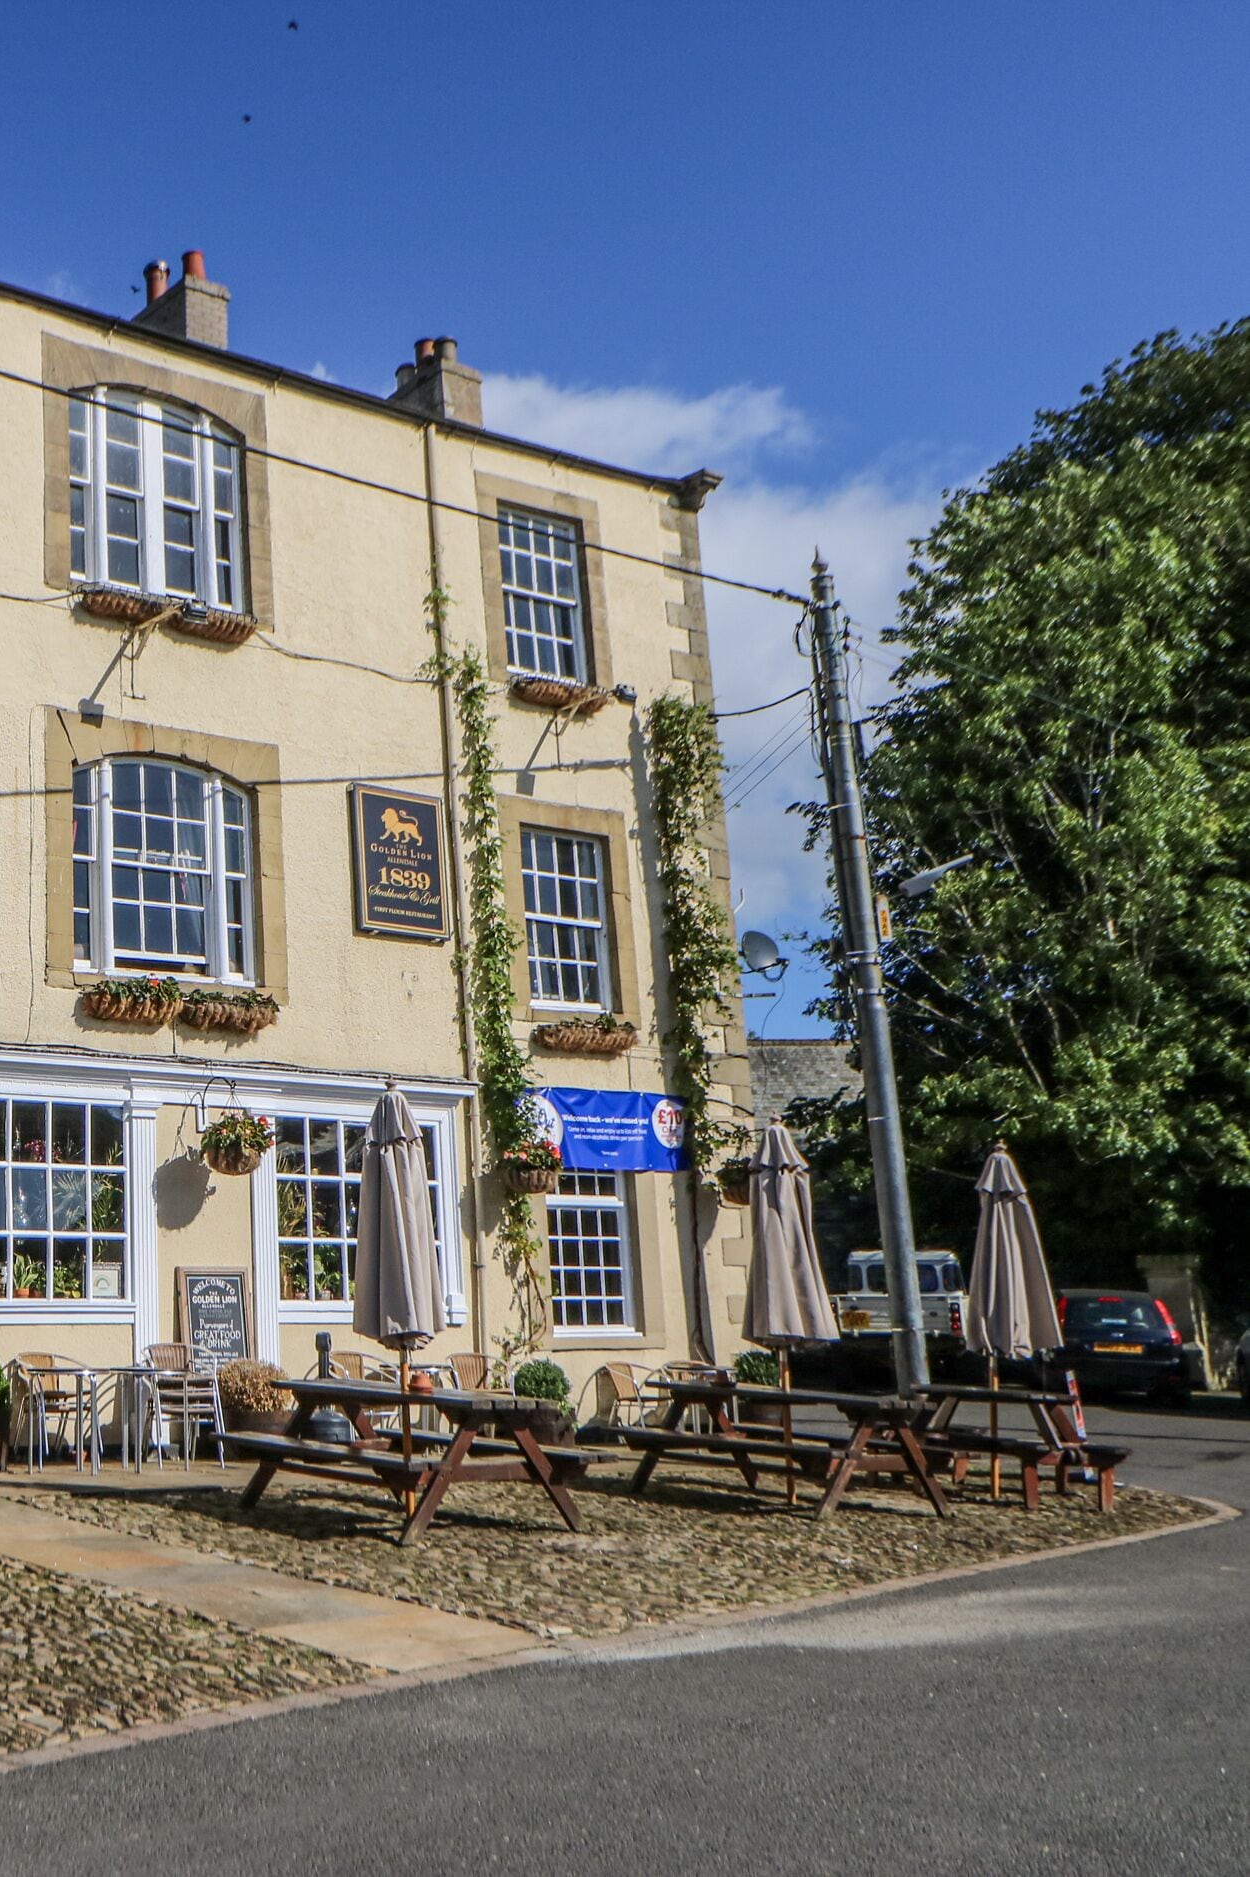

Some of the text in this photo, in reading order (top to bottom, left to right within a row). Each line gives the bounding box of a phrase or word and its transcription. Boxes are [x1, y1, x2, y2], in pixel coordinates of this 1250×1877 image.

[370, 842, 432, 861] GOLDEN LION
[386, 856, 418, 867] ALLENDALE
[378, 866, 431, 891] 1839
[367, 884, 409, 900] Steakhouse
[419, 890, 441, 906] Grill
[658, 1109, 683, 1125] £10
[192, 1278, 236, 1295] WELCOME TO
[191, 1295, 238, 1304] GOLDEN LION
[193, 1329, 241, 1340] GREAT FOOD
[207, 1337, 232, 1349] DRINK
